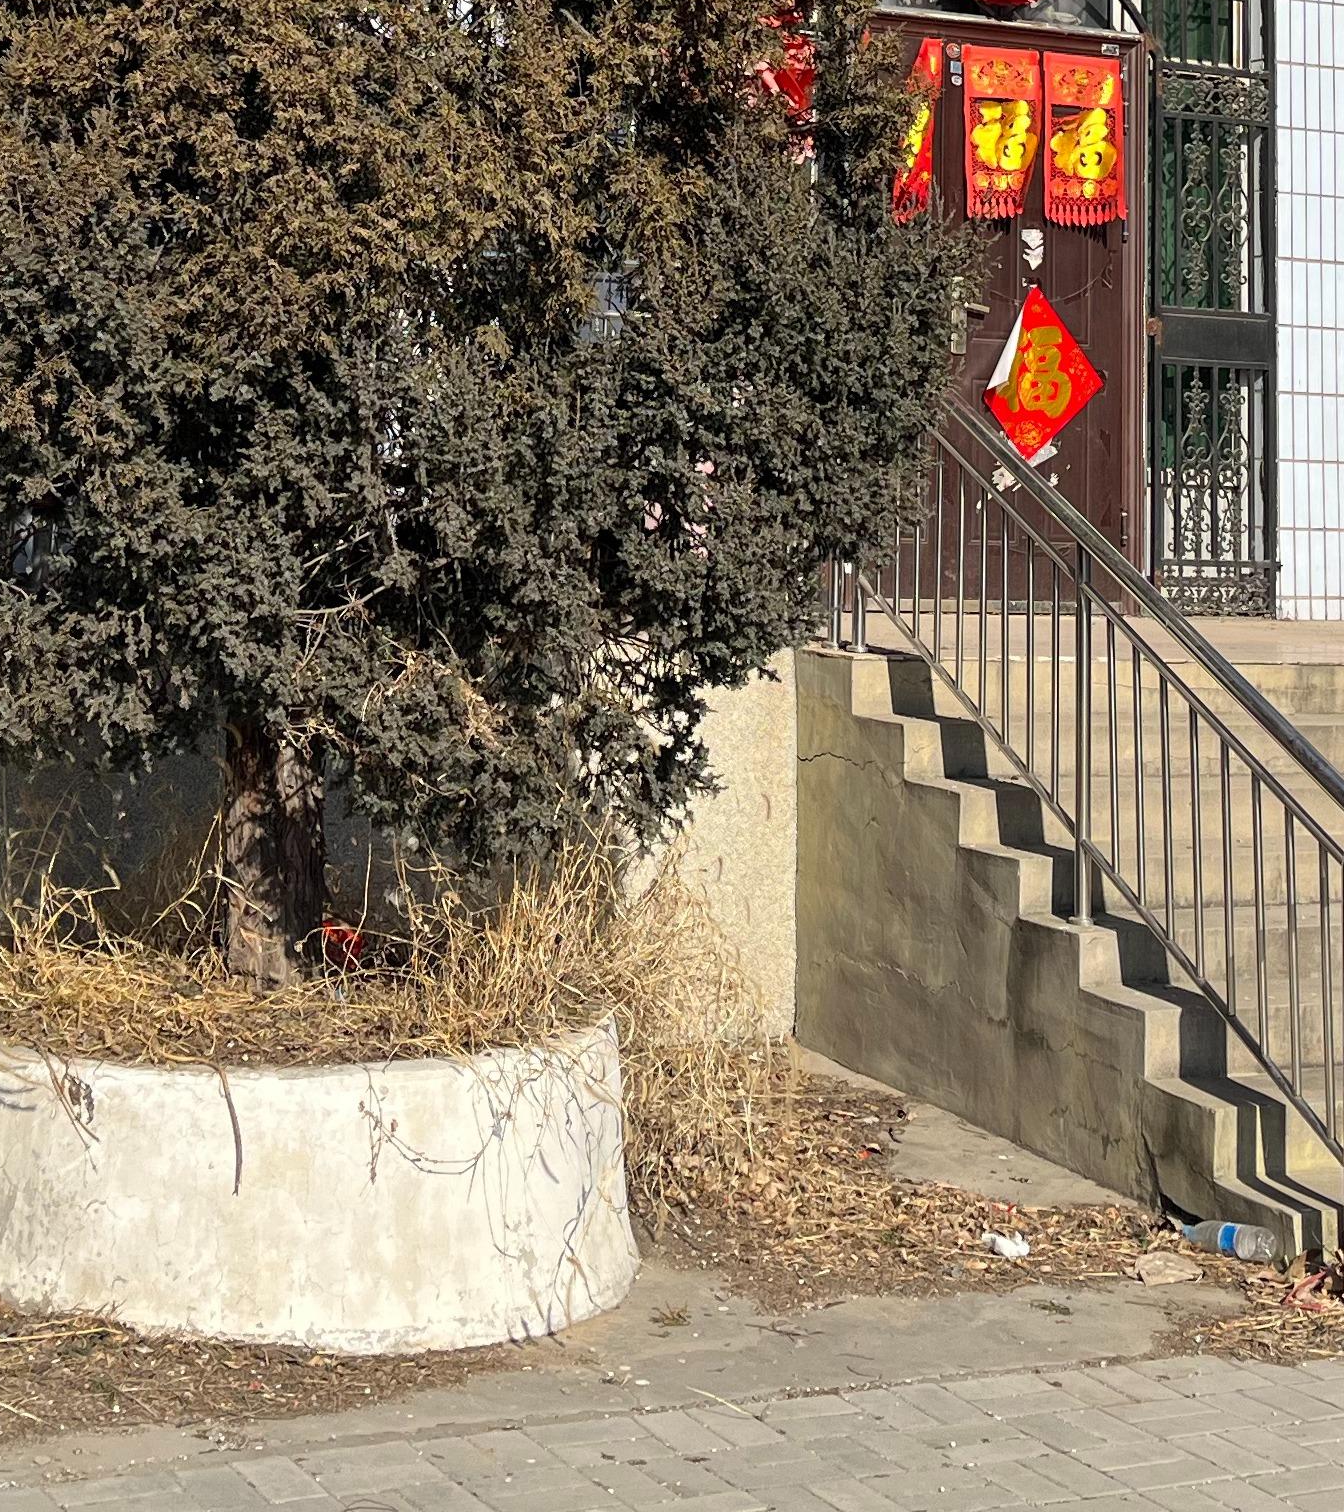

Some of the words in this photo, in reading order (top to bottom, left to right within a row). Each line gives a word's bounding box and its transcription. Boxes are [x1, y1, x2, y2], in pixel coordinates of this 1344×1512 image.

[971, 100, 1038, 172] 福
[1050, 107, 1118, 180] 福
[995, 326, 1072, 419] 福
